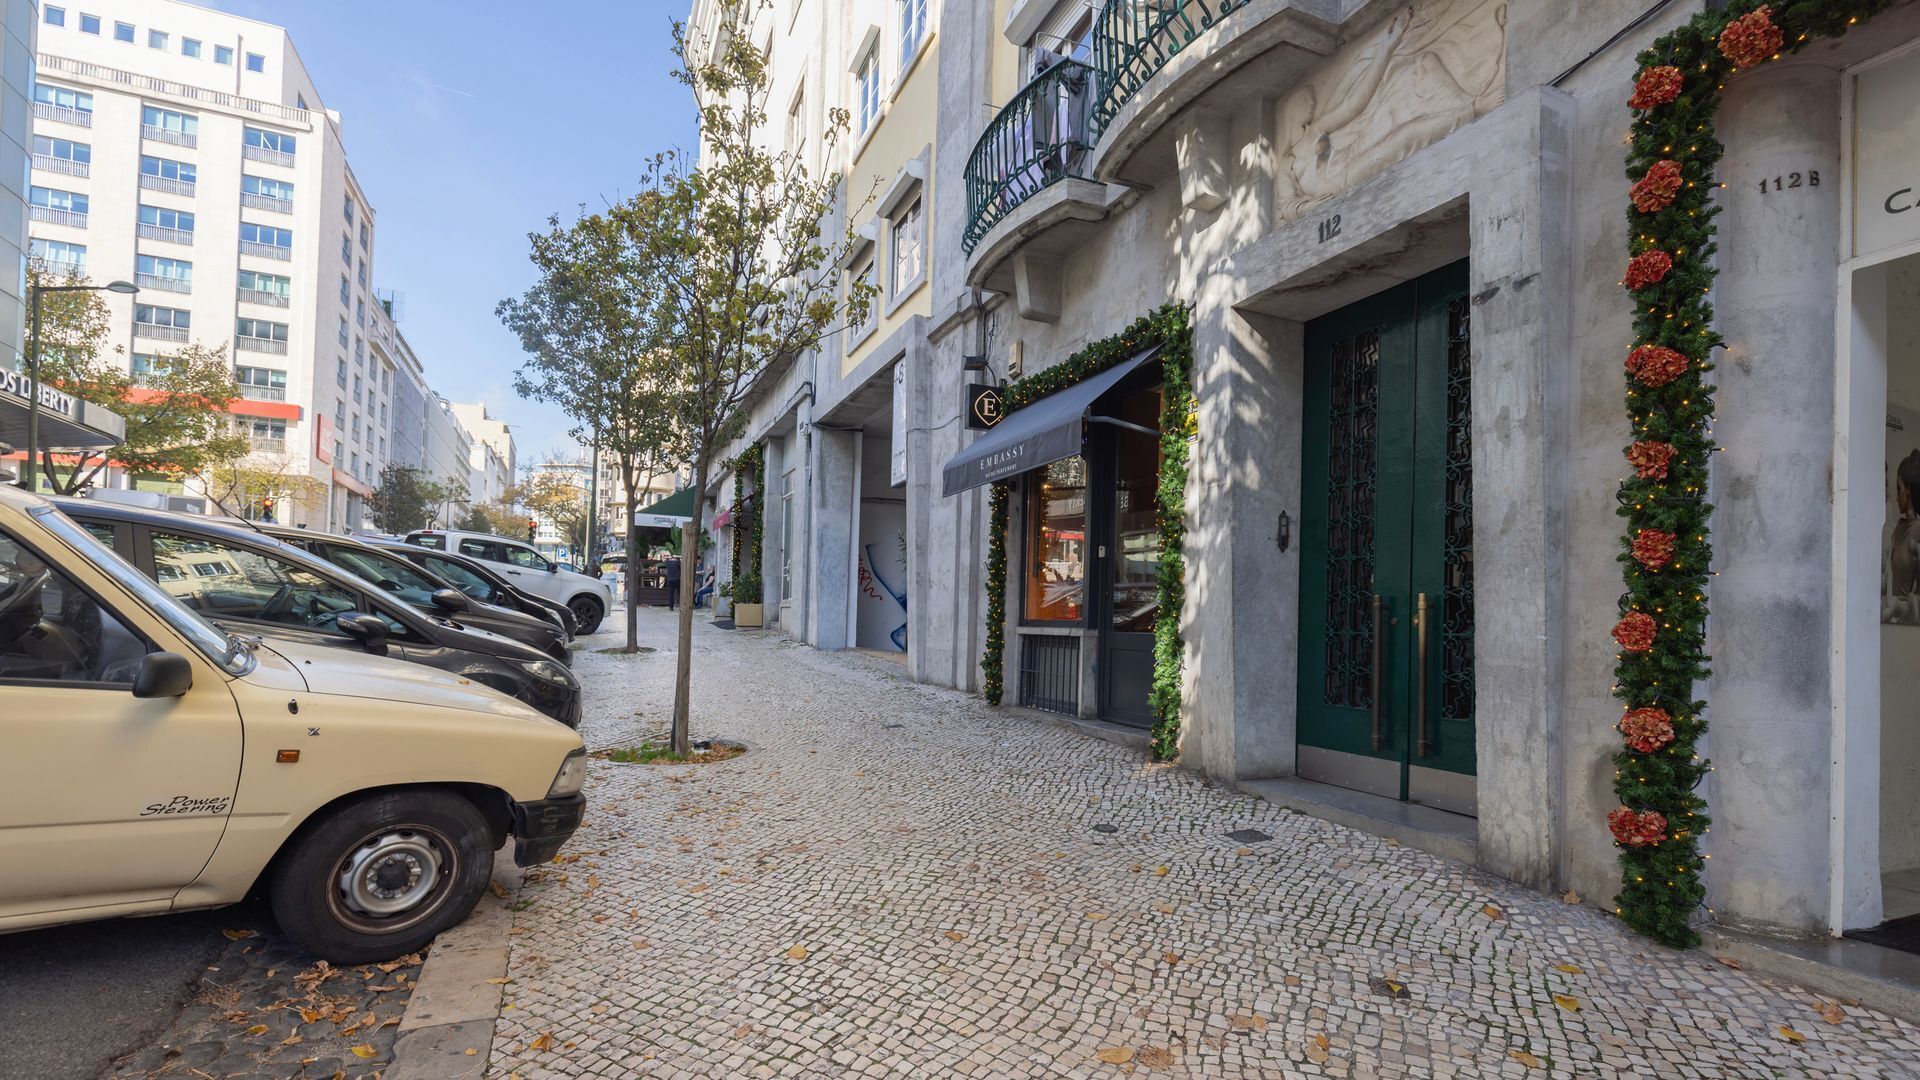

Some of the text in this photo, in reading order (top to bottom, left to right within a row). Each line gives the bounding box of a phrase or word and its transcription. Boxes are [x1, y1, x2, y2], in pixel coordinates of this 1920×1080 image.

[1884, 187, 1920, 214] C
[1318, 214, 1341, 244] 112
[982, 398, 996, 416] E
[980, 444, 1024, 470] EMBASSY
[140, 803, 228, 816] Steering
[168, 795, 230, 807] Power
